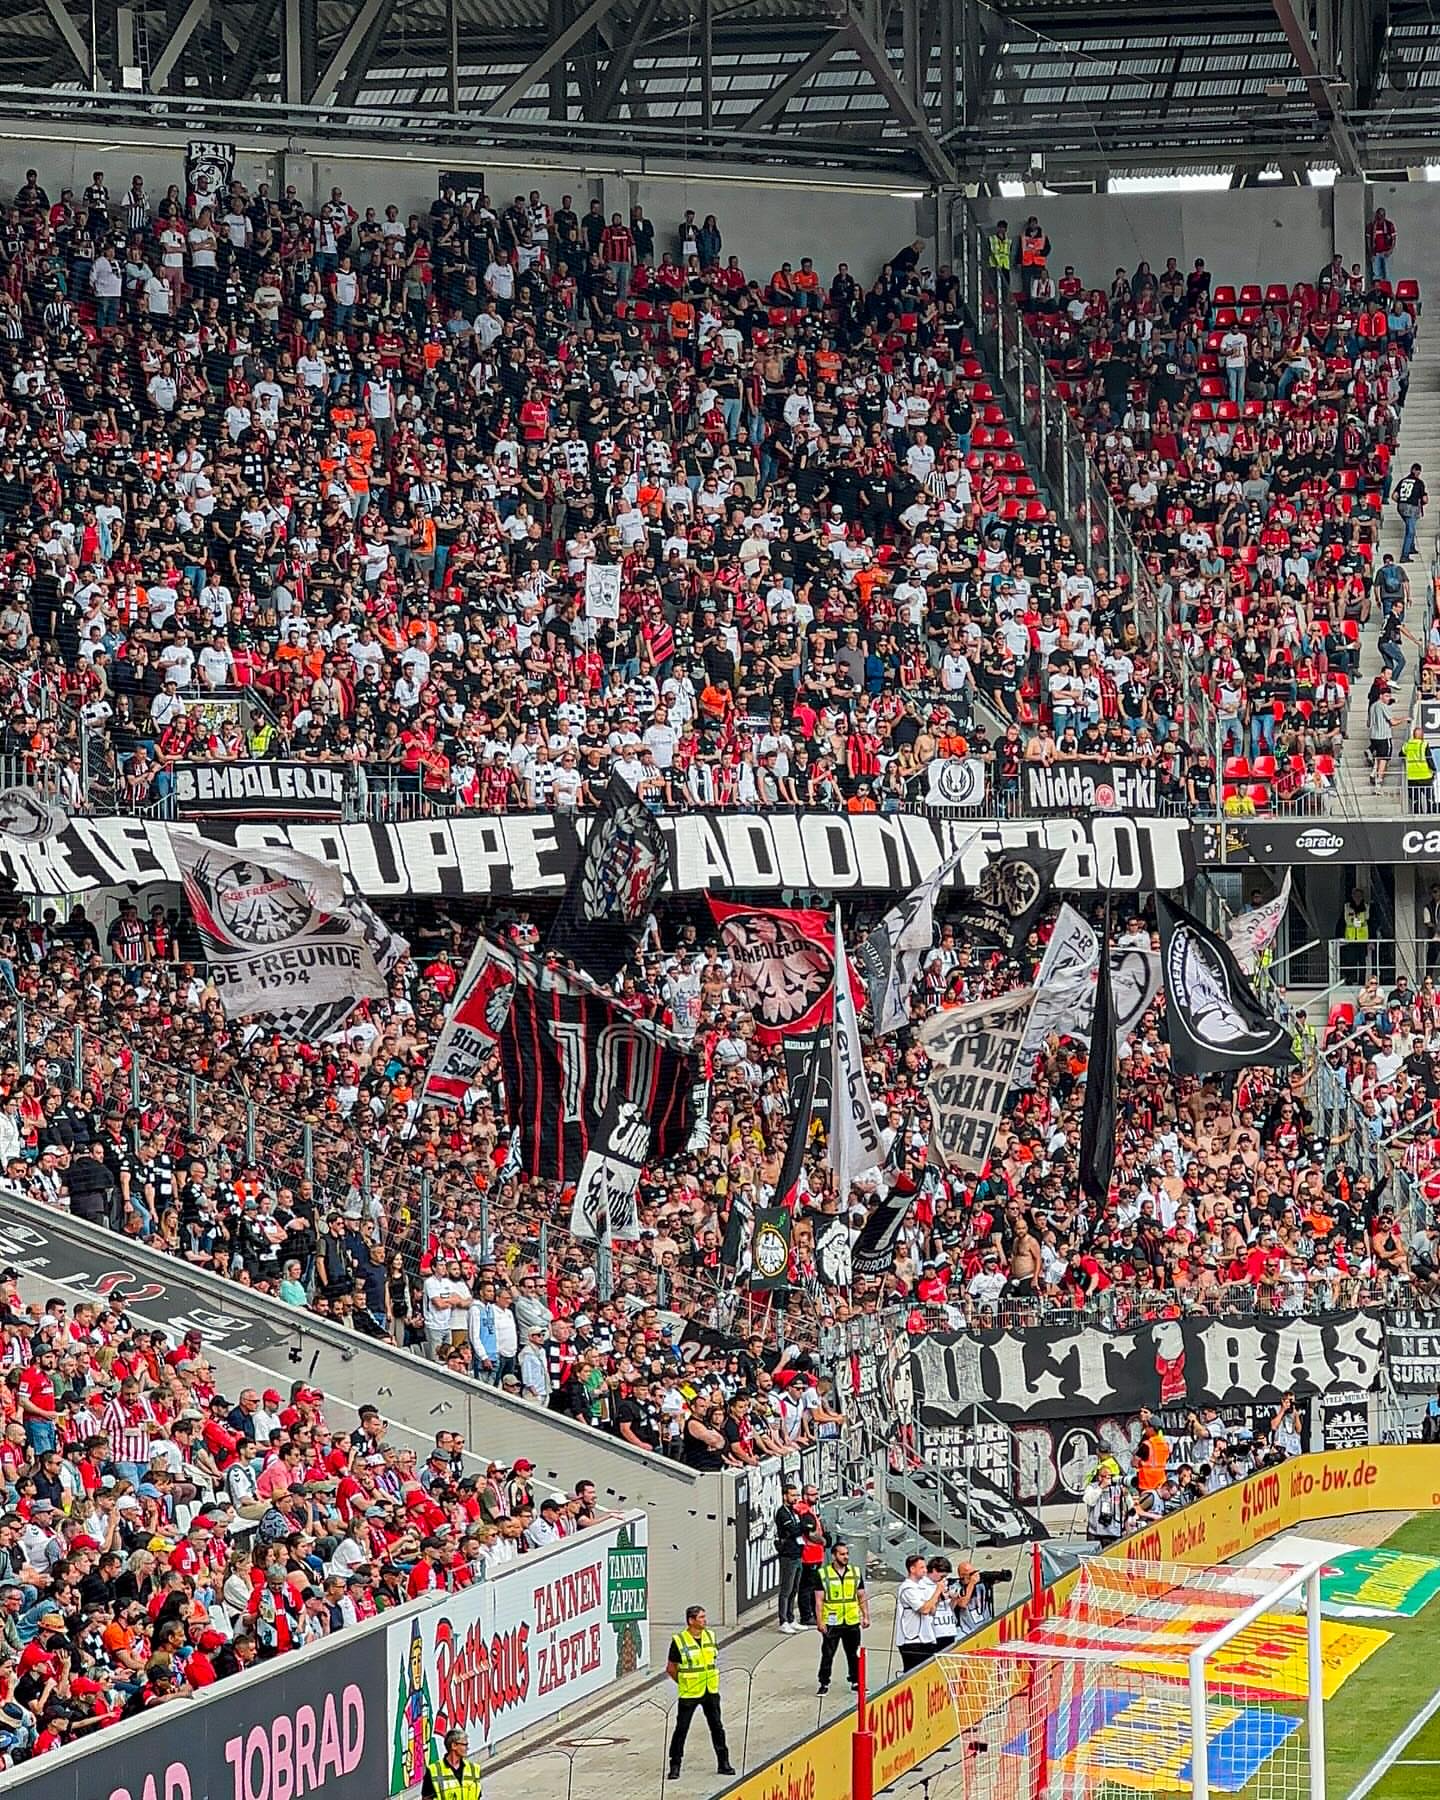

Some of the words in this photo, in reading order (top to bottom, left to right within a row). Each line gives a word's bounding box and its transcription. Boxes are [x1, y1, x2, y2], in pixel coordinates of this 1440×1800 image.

[190, 142, 233, 163] EXIL
[176, 766, 343, 802] BEMBOLEROS
[1030, 767, 1095, 808] Nidda
[1113, 767, 1156, 809] Erki
[1295, 834, 1344, 848] carado
[250, 946, 361, 977] FREUNDE
[258, 969, 311, 989] 1994
[1252, 1474, 1279, 1517] LOTTO
[1290, 1459, 1377, 1500] lotto-bw.de
[609, 1553, 646, 1581] TANNEN
[533, 1561, 602, 1634] TANNEN
[610, 1583, 646, 1615] ZÄPFLE
[537, 1622, 601, 1697] ZÄPFLE
[434, 1617, 530, 1742] Rothaus
[881, 1686, 914, 1748] LOTTO
[225, 1684, 366, 1800] JOBRAD
